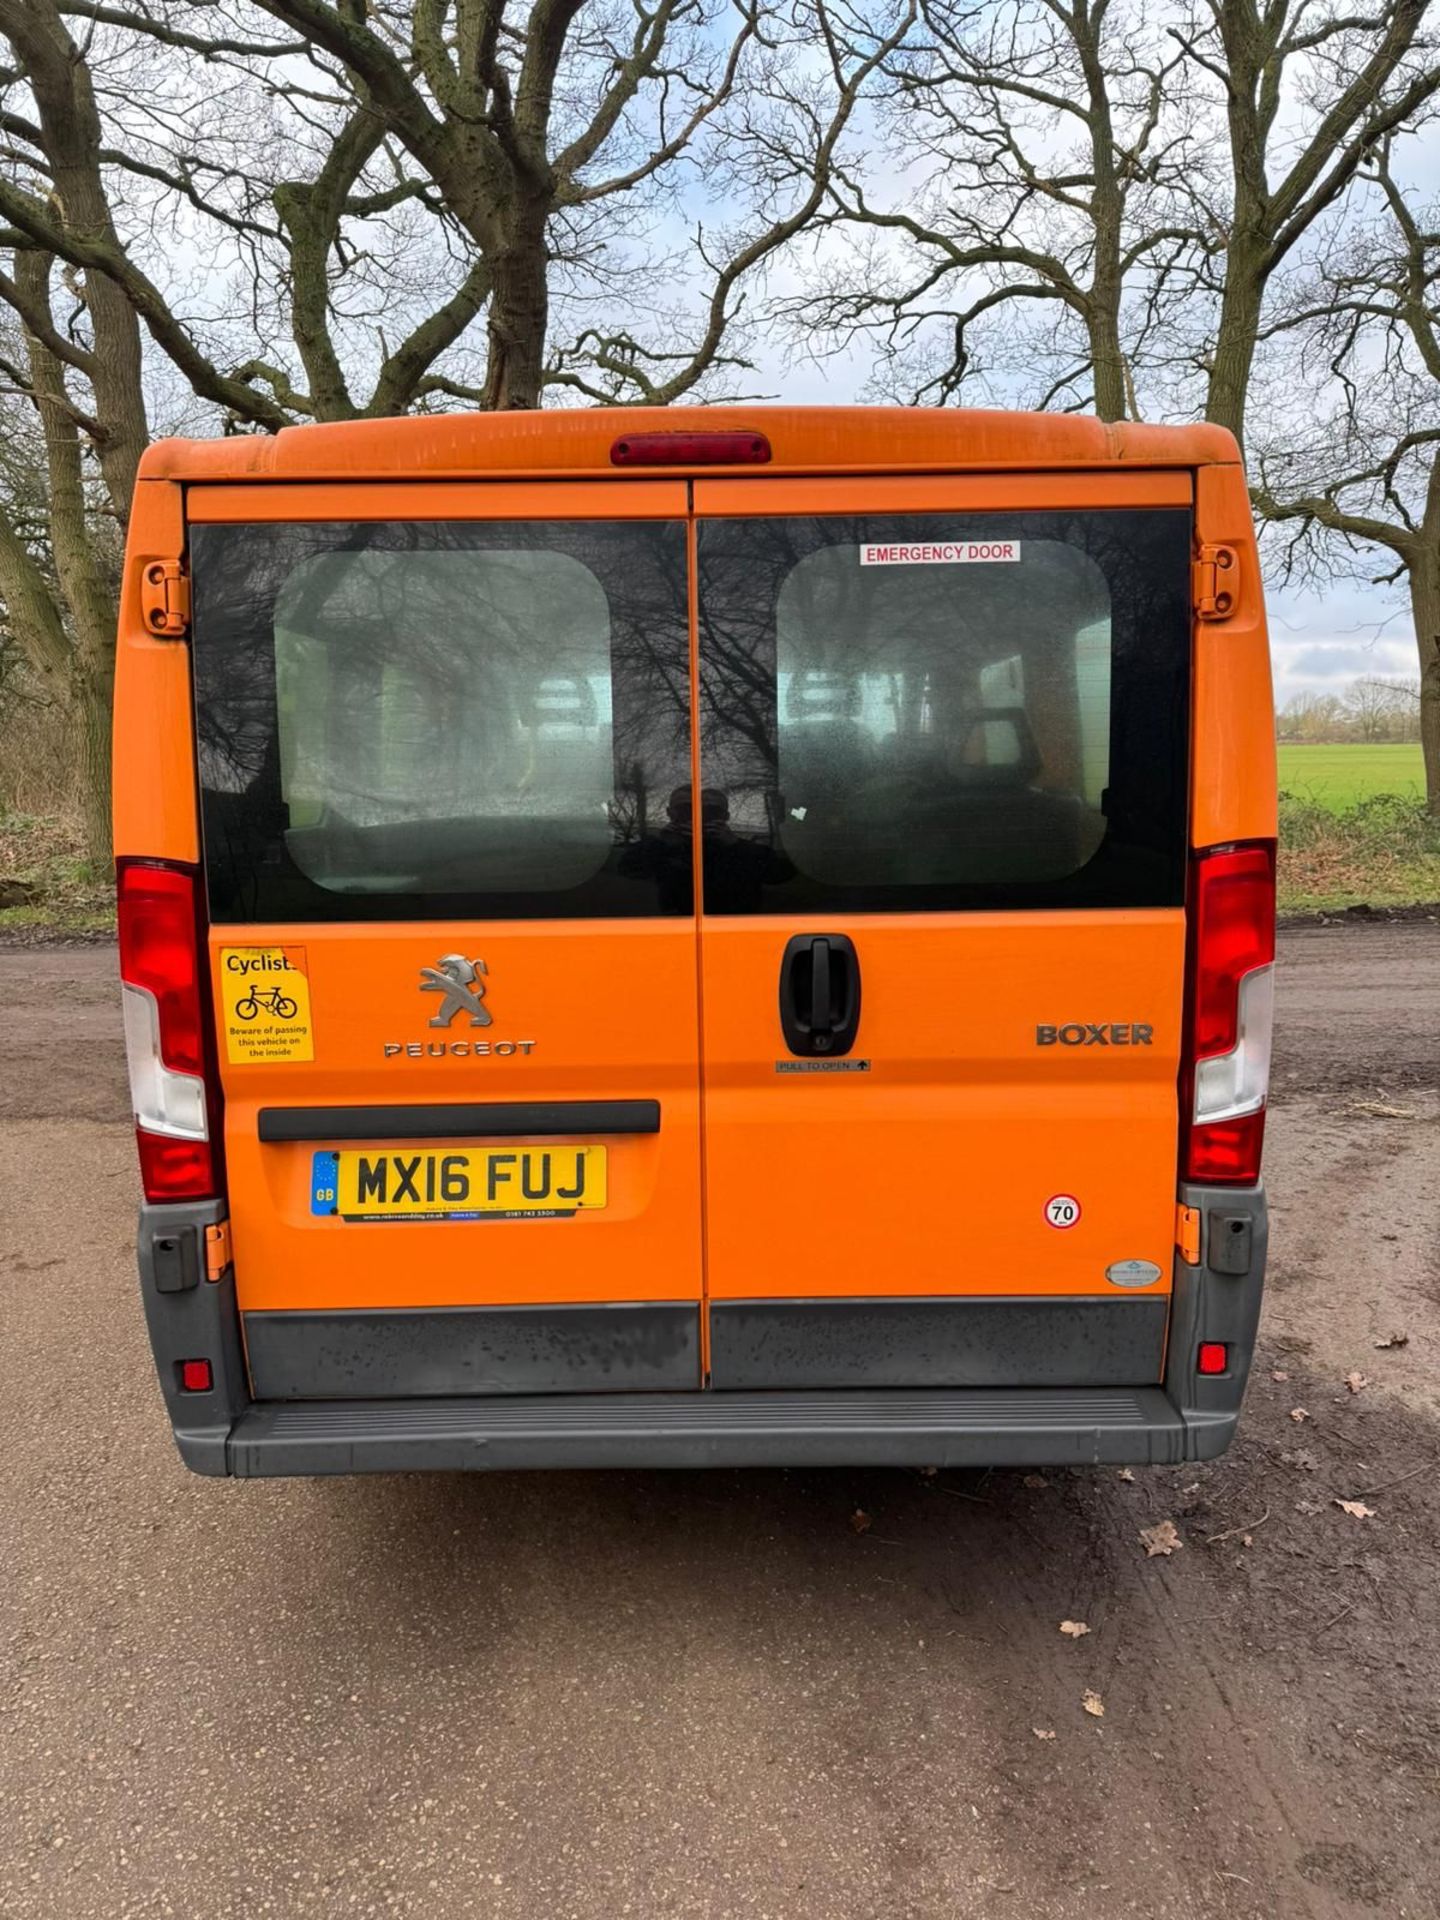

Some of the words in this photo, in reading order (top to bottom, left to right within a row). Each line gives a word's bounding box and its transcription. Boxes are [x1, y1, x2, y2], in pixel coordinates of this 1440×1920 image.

[866, 545, 963, 562] EMERGENCY
[968, 544, 1013, 559] DOOR
[227, 954, 298, 976] Cyclist
[229, 1026, 262, 1035] Beware
[263, 1026, 273, 1034] of
[275, 1025, 307, 1035] passing
[1036, 1023, 1154, 1046] BOXER
[238, 1038, 255, 1047] this
[256, 1037, 288, 1046] vehicle
[289, 1037, 301, 1045] on
[384, 1040, 537, 1057] PEUGEOT
[249, 1049, 264, 1057] the
[265, 1048, 292, 1057] inside
[779, 1062, 801, 1070] PULL
[807, 1061, 820, 1069] TO
[822, 1061, 850, 1069] OPEN
[357, 1156, 470, 1204] MX16
[488, 1152, 586, 1200] FUJ
[316, 1188, 334, 1202] GB
[1052, 1206, 1074, 1221] 70
